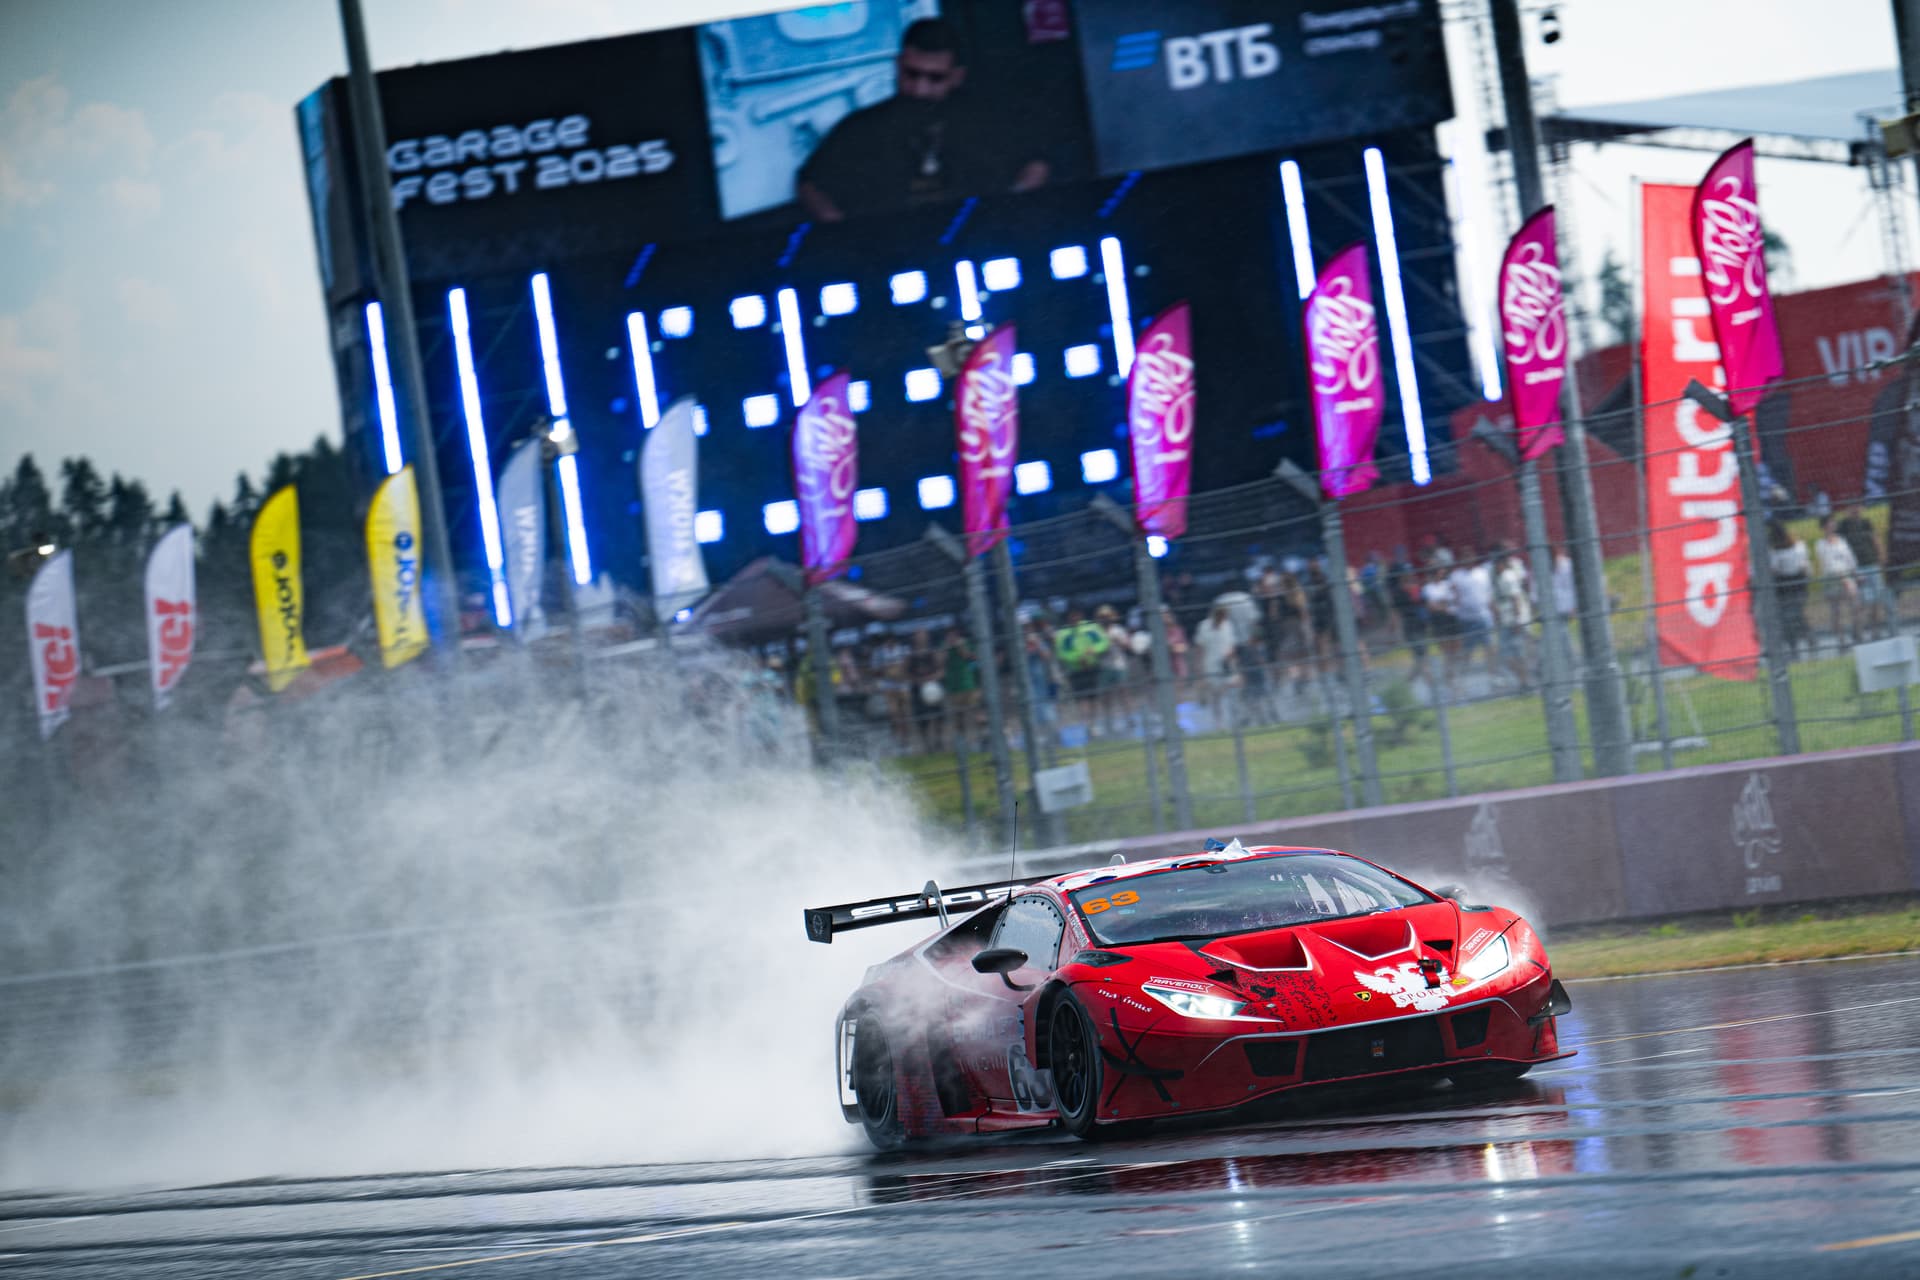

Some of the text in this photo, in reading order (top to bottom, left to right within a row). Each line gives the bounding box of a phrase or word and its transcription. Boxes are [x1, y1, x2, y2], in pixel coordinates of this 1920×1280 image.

[1163, 23, 1281, 90] ВТБ
[534, 138, 676, 189] 2025
[1814, 326, 1896, 384] VIP
[1081, 890, 1141, 915] 63
[1152, 979, 1206, 991] RAVENOL
[1398, 986, 1449, 1003] SPORA
